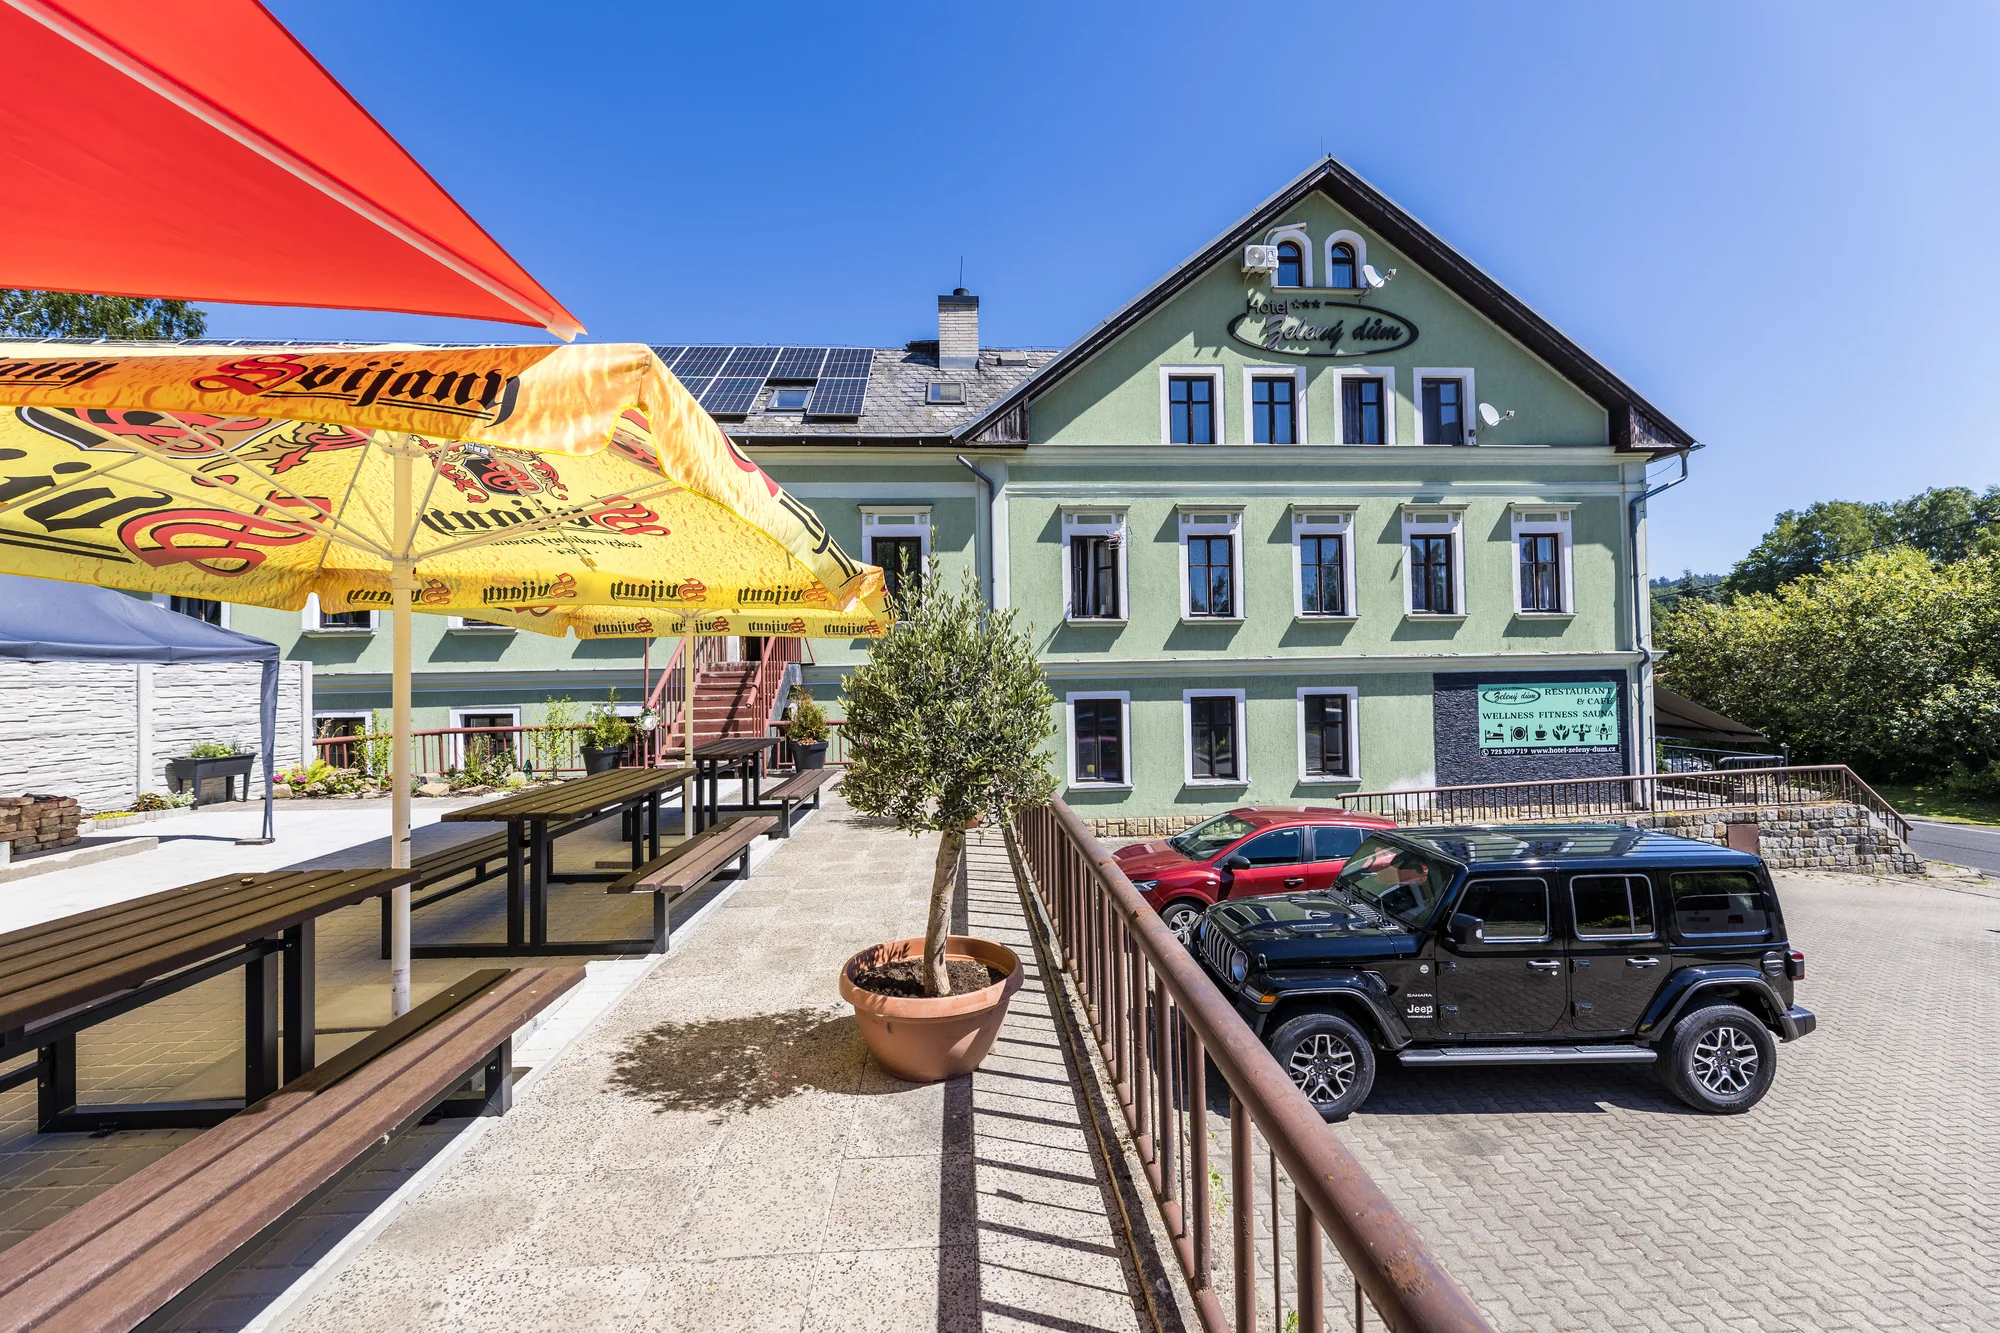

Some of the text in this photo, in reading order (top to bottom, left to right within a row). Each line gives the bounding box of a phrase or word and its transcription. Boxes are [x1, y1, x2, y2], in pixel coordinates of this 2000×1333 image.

[1247, 298, 1289, 315] Hotel
[1265, 314, 1403, 350] Zelený dům
[190, 354, 521, 428] Svijany
[1545, 687, 1612, 696] RESTAURANT
[1577, 697, 1584, 705] &
[1482, 710, 1614, 720] WELLNESS FITNESS SAUNA
[1530, 746, 1616, 754] www.hotel-zeleny-dum.cz
[1407, 1004, 1433, 1015] Jeep
